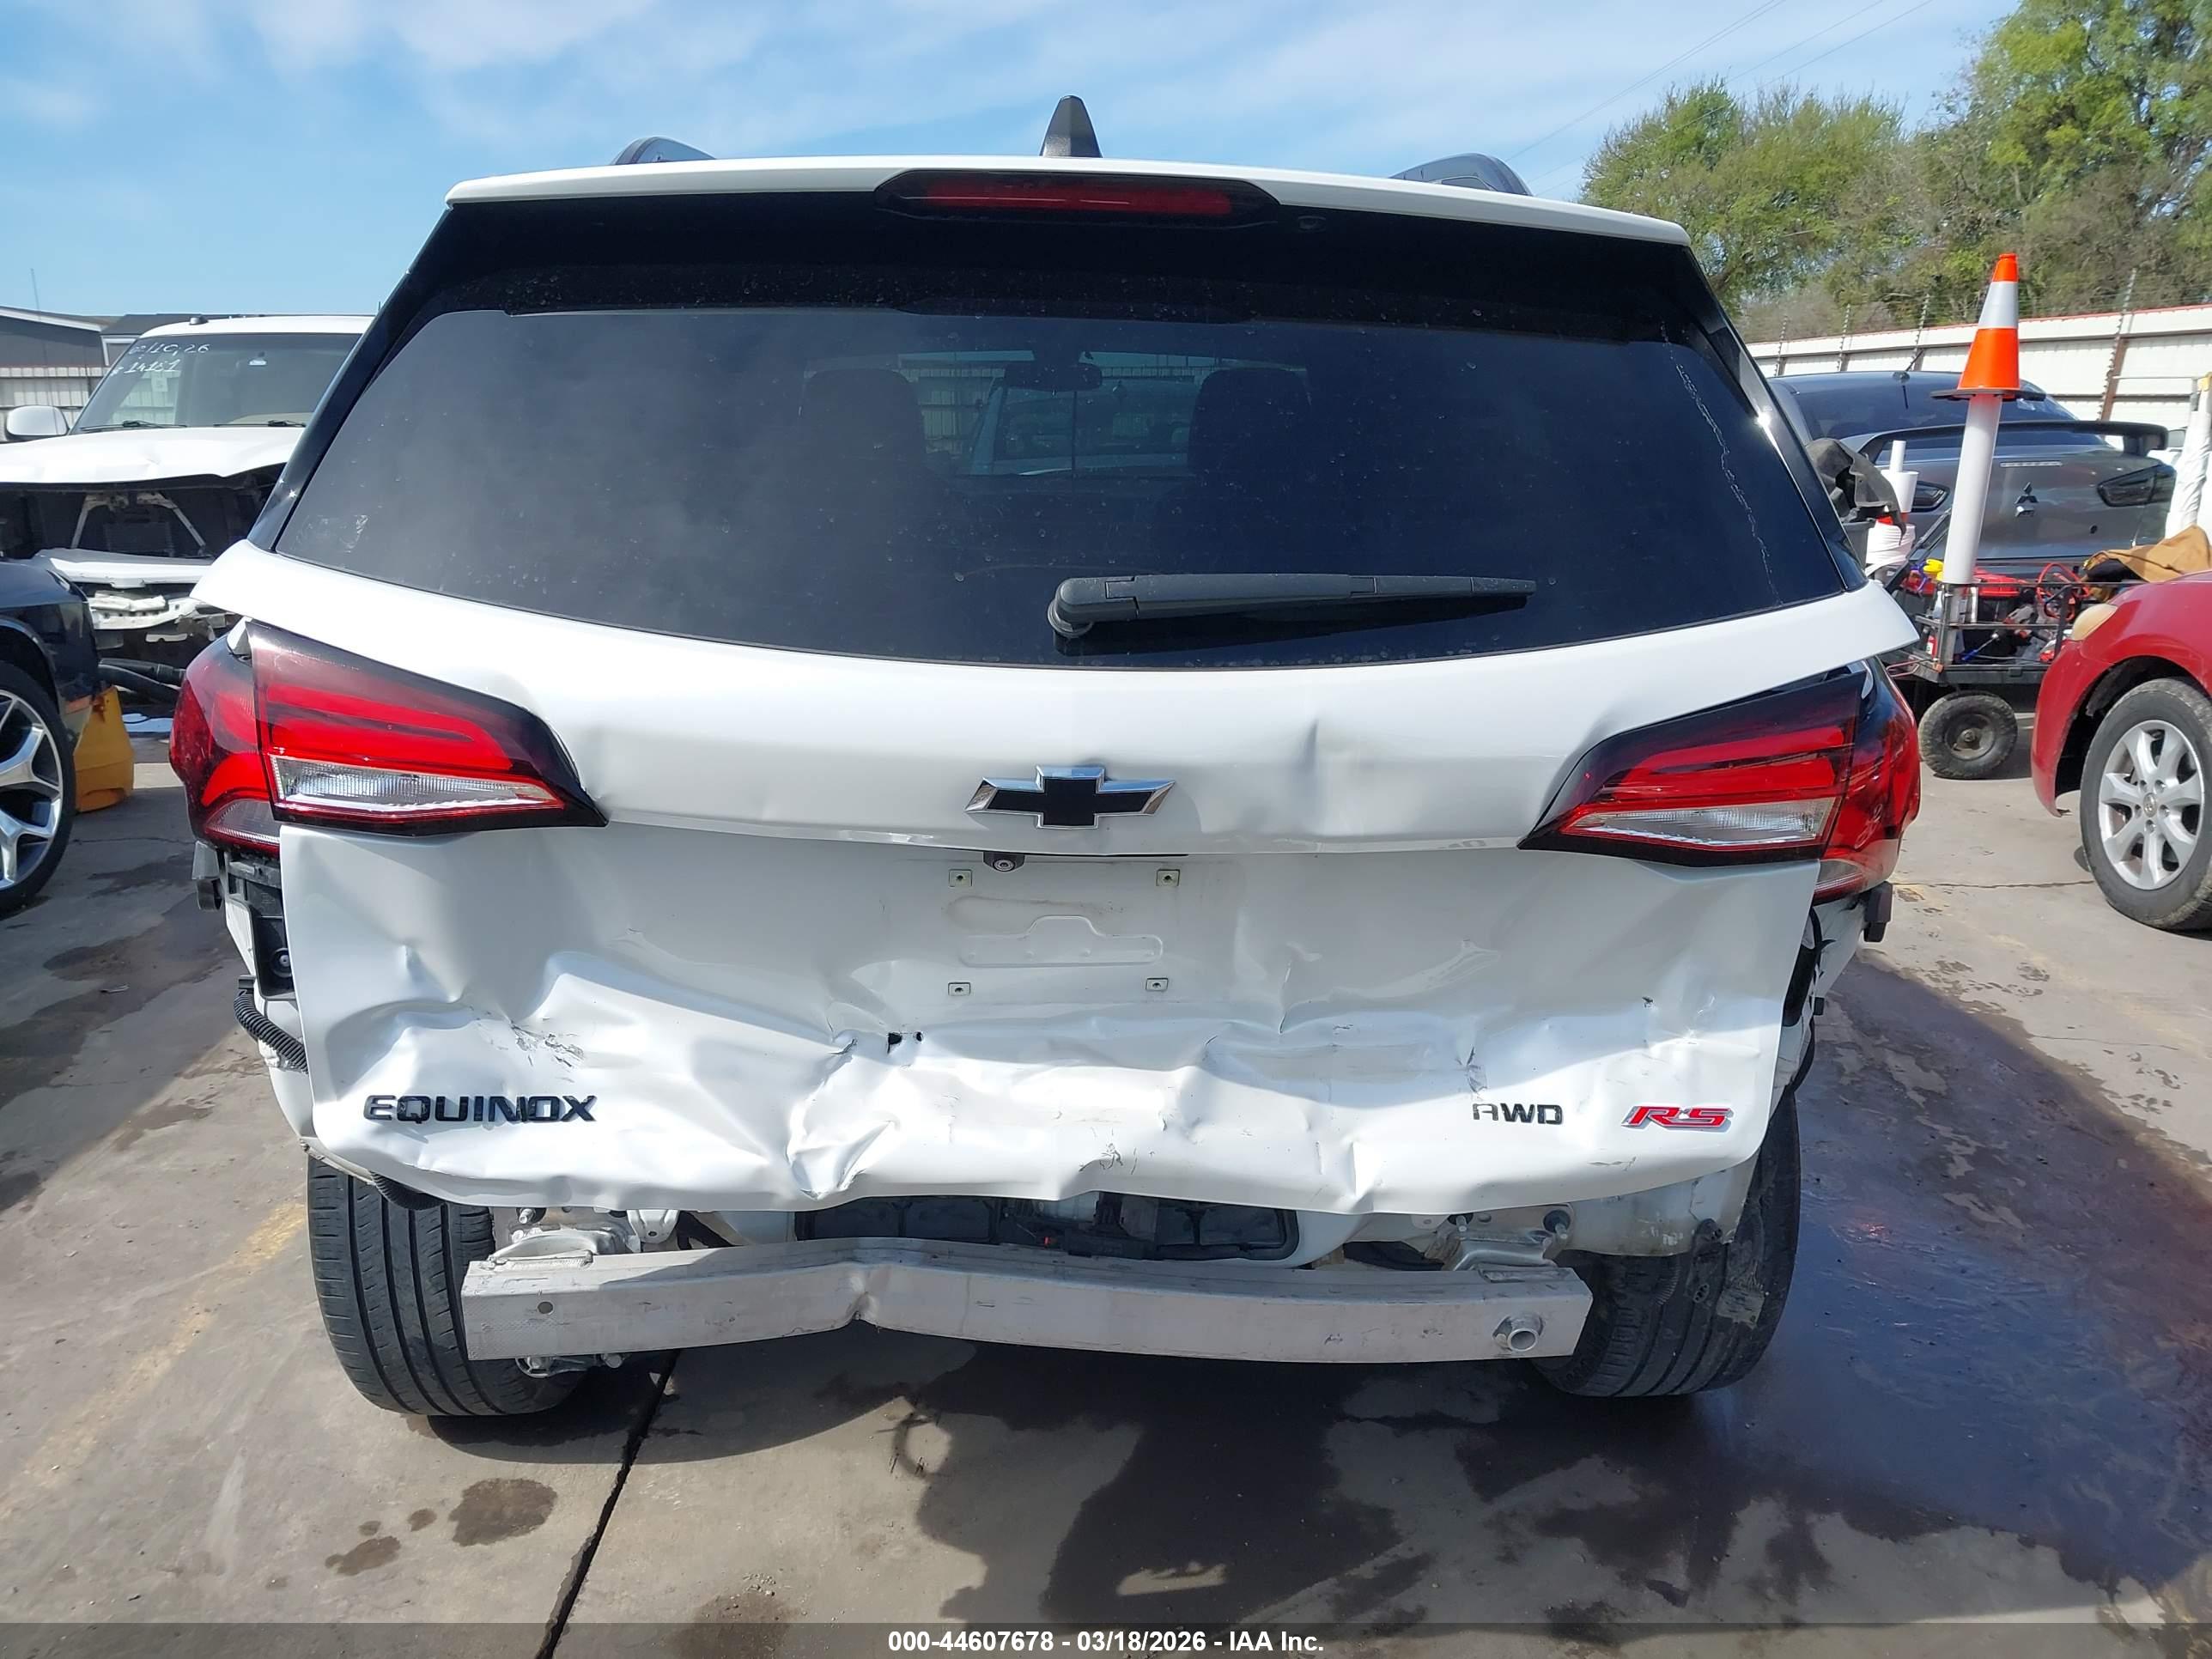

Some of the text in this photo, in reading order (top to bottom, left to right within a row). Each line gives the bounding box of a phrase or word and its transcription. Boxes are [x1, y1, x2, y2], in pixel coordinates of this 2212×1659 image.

[363, 1095, 598, 1123] EQUINOX
[1472, 1103, 1563, 1125] AWD
[1621, 1104, 1733, 1129] RS
